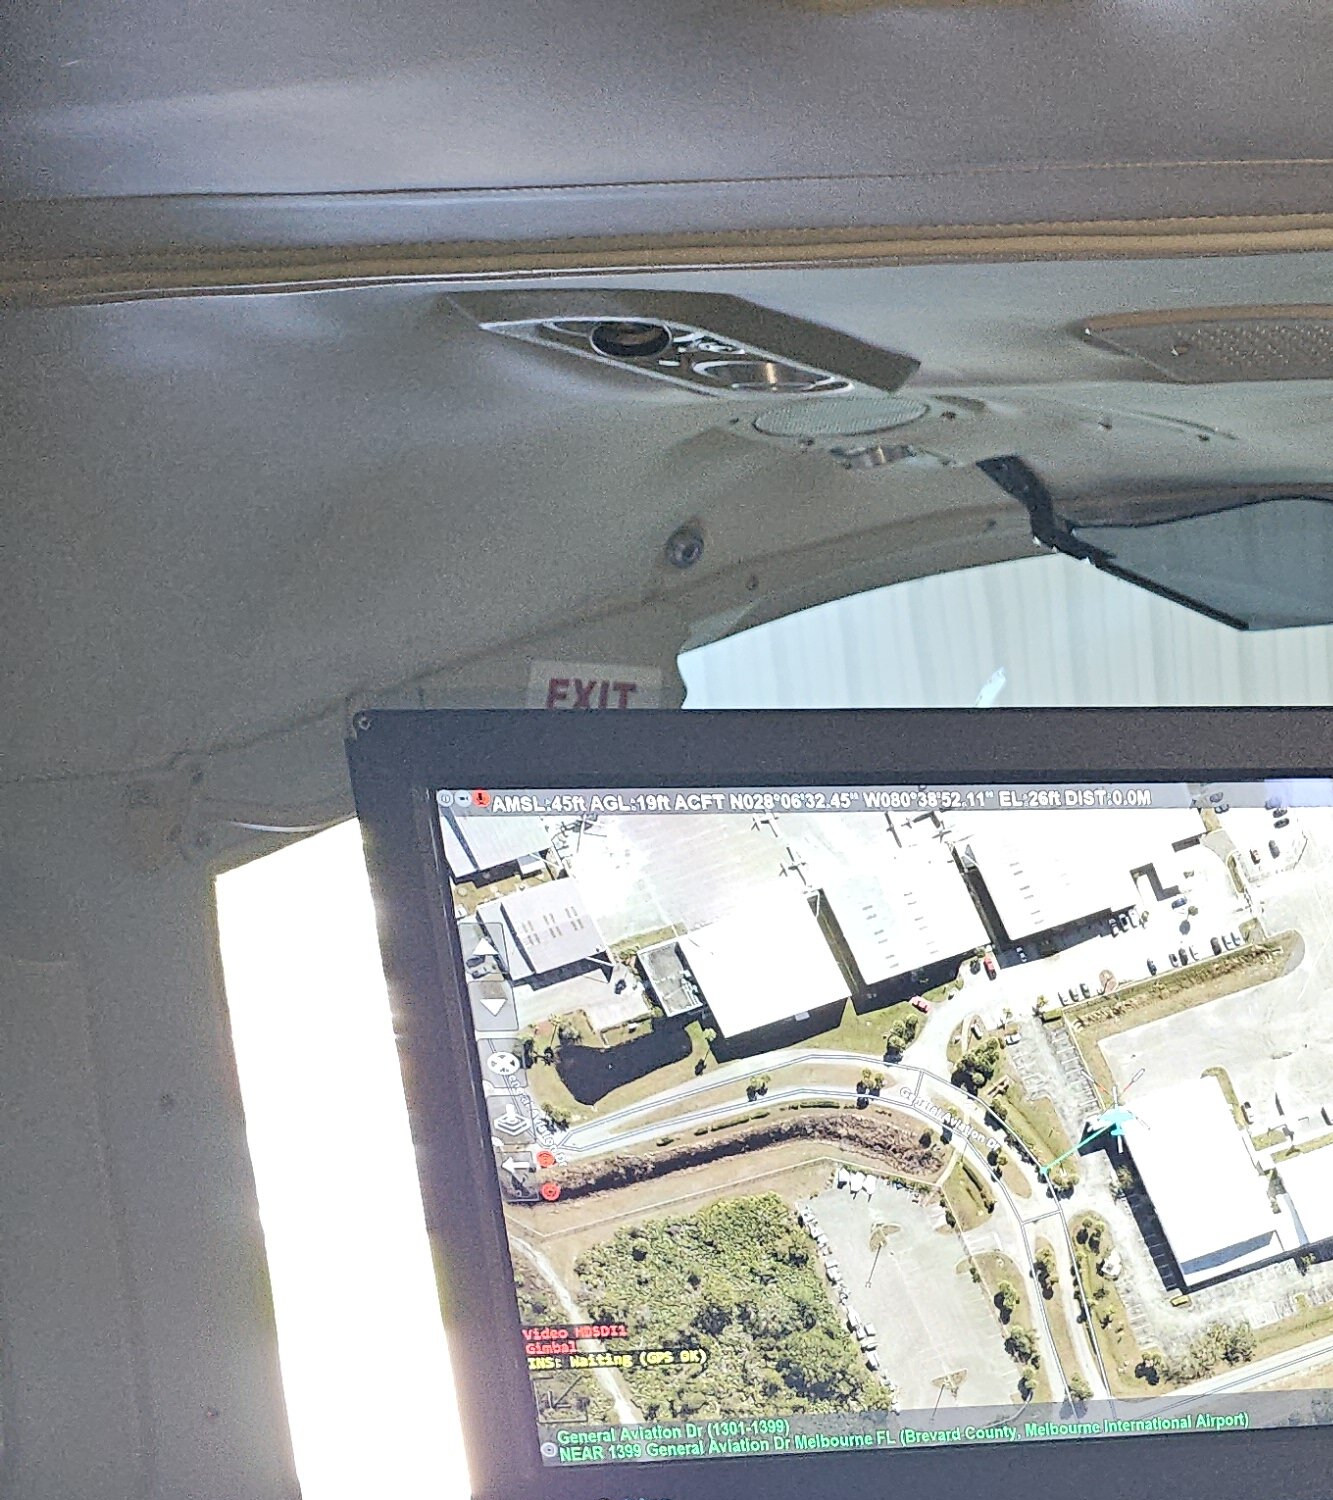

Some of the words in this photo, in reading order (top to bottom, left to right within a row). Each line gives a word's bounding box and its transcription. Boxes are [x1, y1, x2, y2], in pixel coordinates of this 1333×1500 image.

[492, 794, 586, 813] AMSL:45ft
[589, 794, 671, 811] AGL:19ft
[674, 793, 725, 811] ACFT
[999, 789, 1062, 807] EL:26ft
[1065, 789, 1152, 806] DIST:0.0M
[558, 1429, 615, 1446] General
[620, 1425, 680, 1443] Aviation
[685, 1424, 702, 1440] Dr
[707, 1419, 790, 1439] (1301-1399)
[559, 1445, 601, 1462] NEAR
[608, 1443, 641, 1459] 1399
[647, 1441, 702, 1457] General
[708, 1438, 769, 1454] Aviation
[773, 1436, 790, 1450] Dr
[795, 1433, 874, 1449] Melbourne
[877, 1430, 896, 1445] FL
[899, 1427, 961, 1446] (Brevard
[965, 1425, 1021, 1443] County,
[1025, 1421, 1101, 1437] Melbourne
[1103, 1416, 1192, 1433] International
[1195, 1412, 1250, 1431] Airport)
